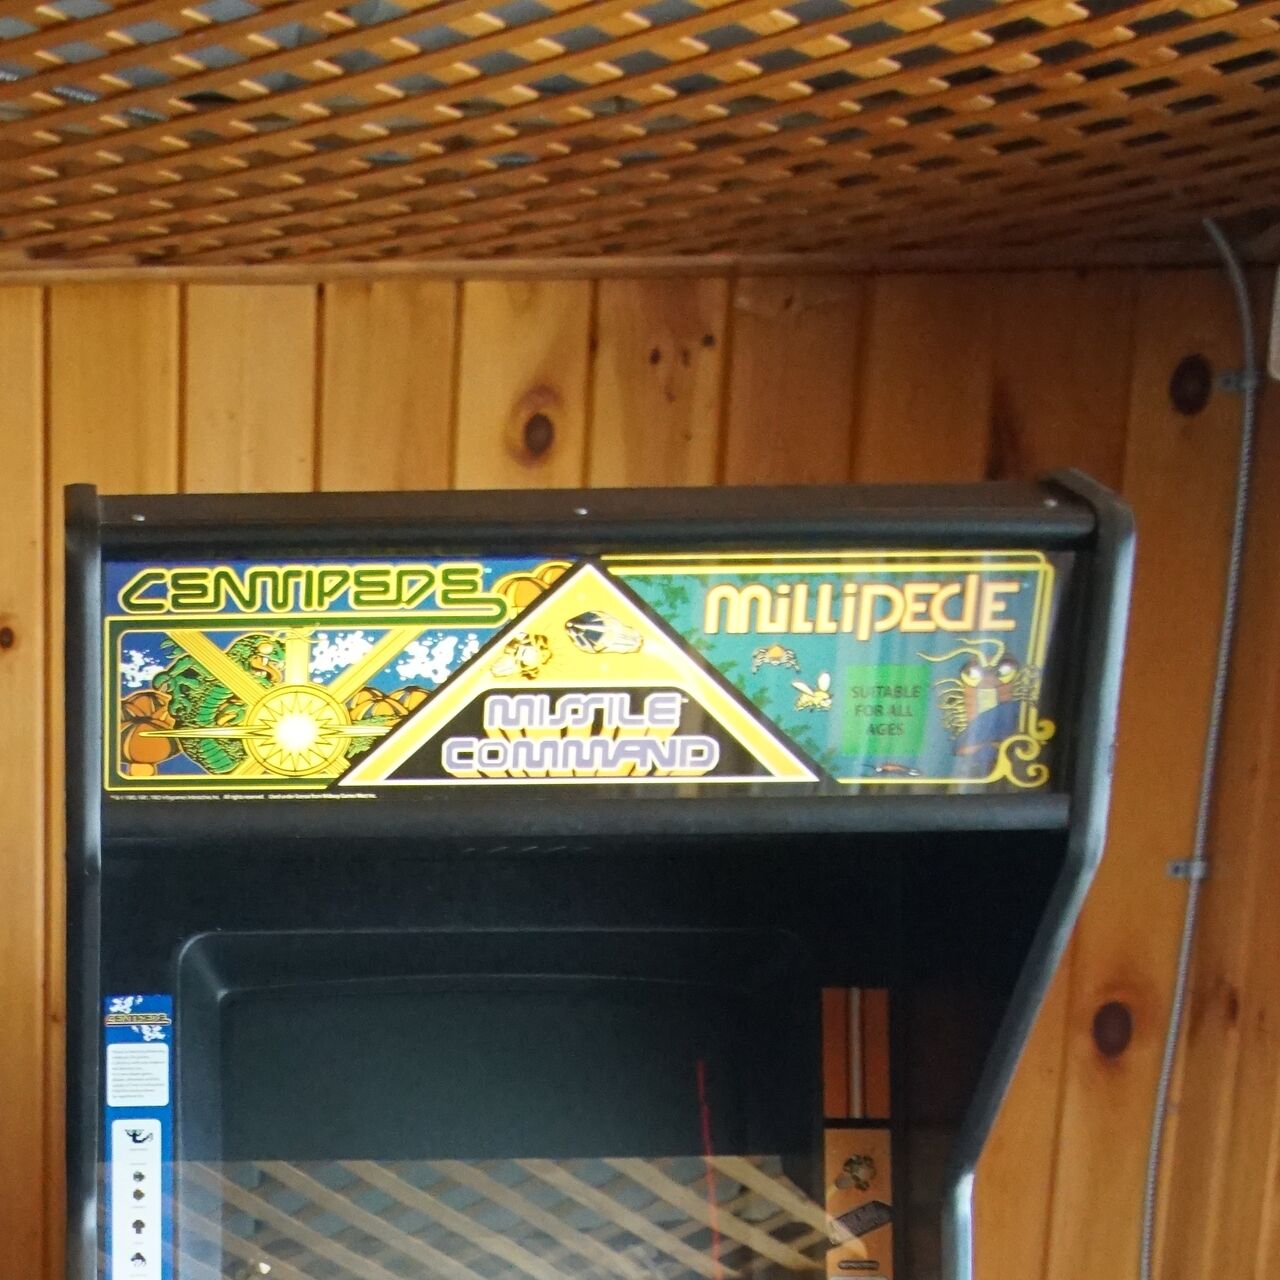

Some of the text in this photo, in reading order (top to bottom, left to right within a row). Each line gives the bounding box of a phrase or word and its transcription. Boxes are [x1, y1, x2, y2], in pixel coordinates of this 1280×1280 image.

[119, 563, 484, 613] CENTIPEDE
[851, 685, 921, 698] SUITABLE
[483, 692, 681, 728] MISSILE
[854, 704, 913, 717] FOR ALL
[867, 723, 904, 736] AGES
[442, 736, 720, 777] COMMAND
